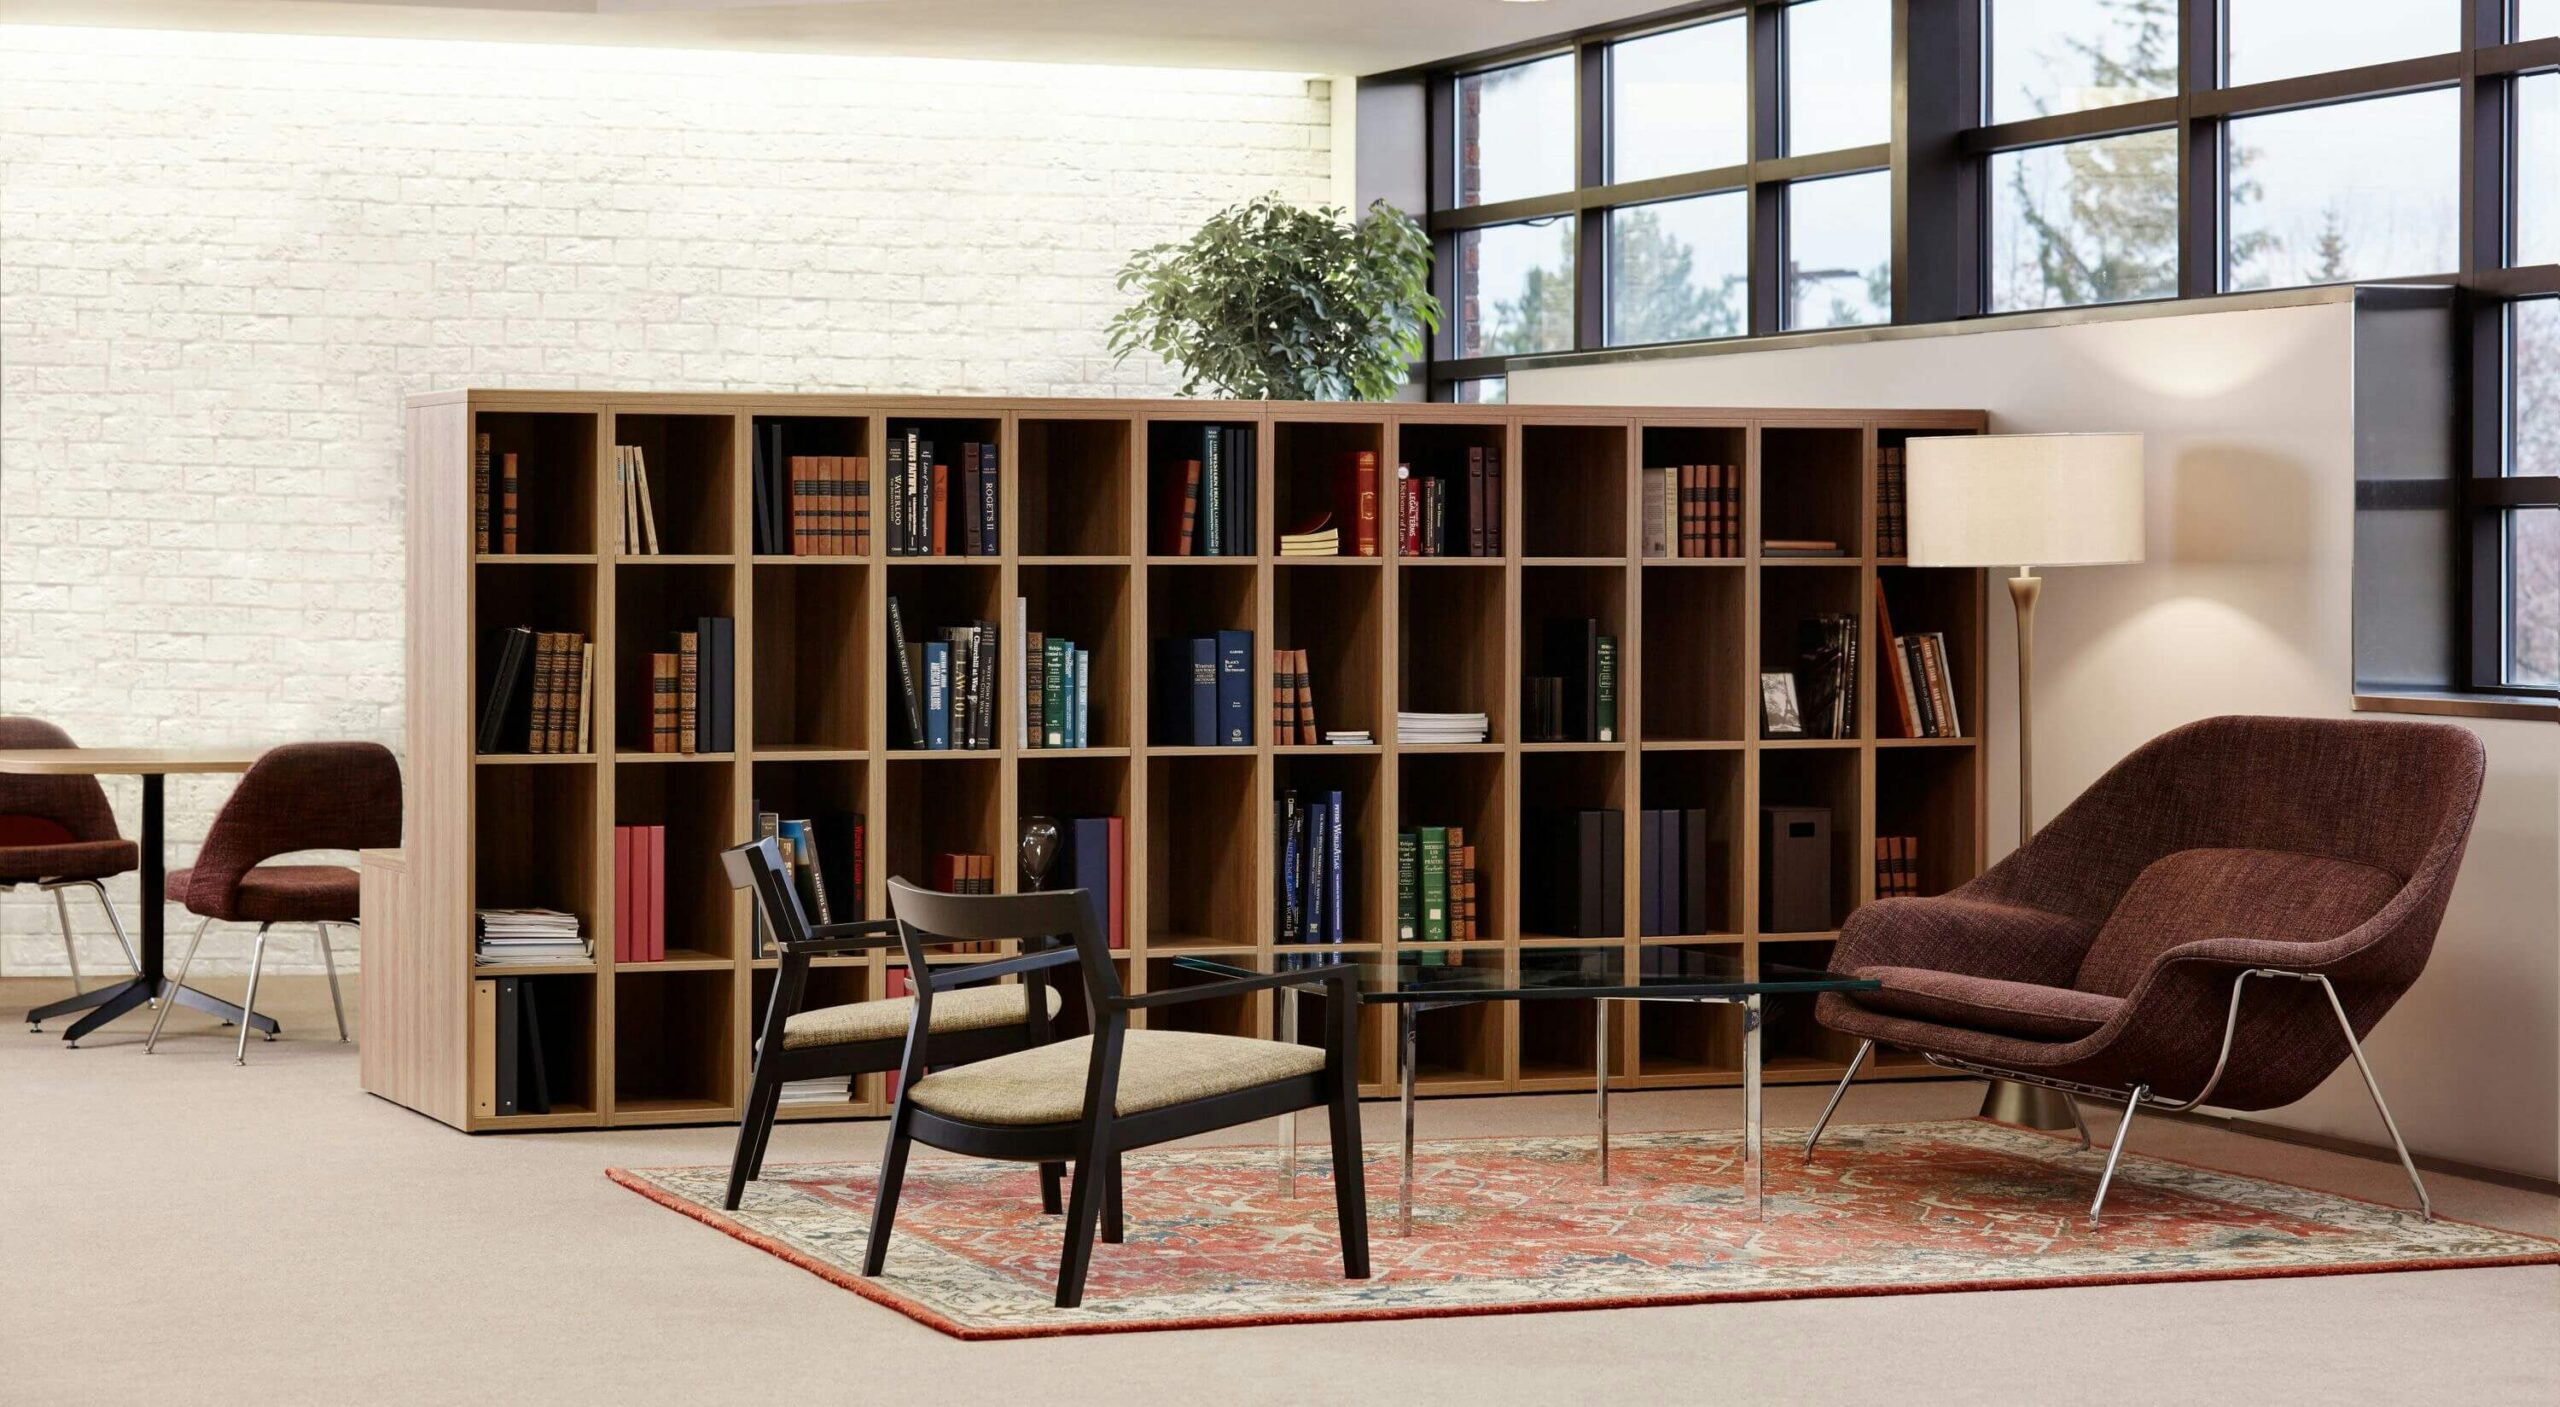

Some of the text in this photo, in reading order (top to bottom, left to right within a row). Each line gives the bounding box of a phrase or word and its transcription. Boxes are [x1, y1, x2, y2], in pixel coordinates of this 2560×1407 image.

[908, 433, 917, 461] ALWAYS
[908, 462, 917, 496] FAITHFUL
[972, 635, 981, 668] Churchill
[899, 649, 909, 675] WORLD
[904, 676, 914, 696] ATLAS
[955, 661, 966, 717] LAW 101
[971, 677, 979, 693] War
[814, 872, 825, 907] BEAUTIFUL
